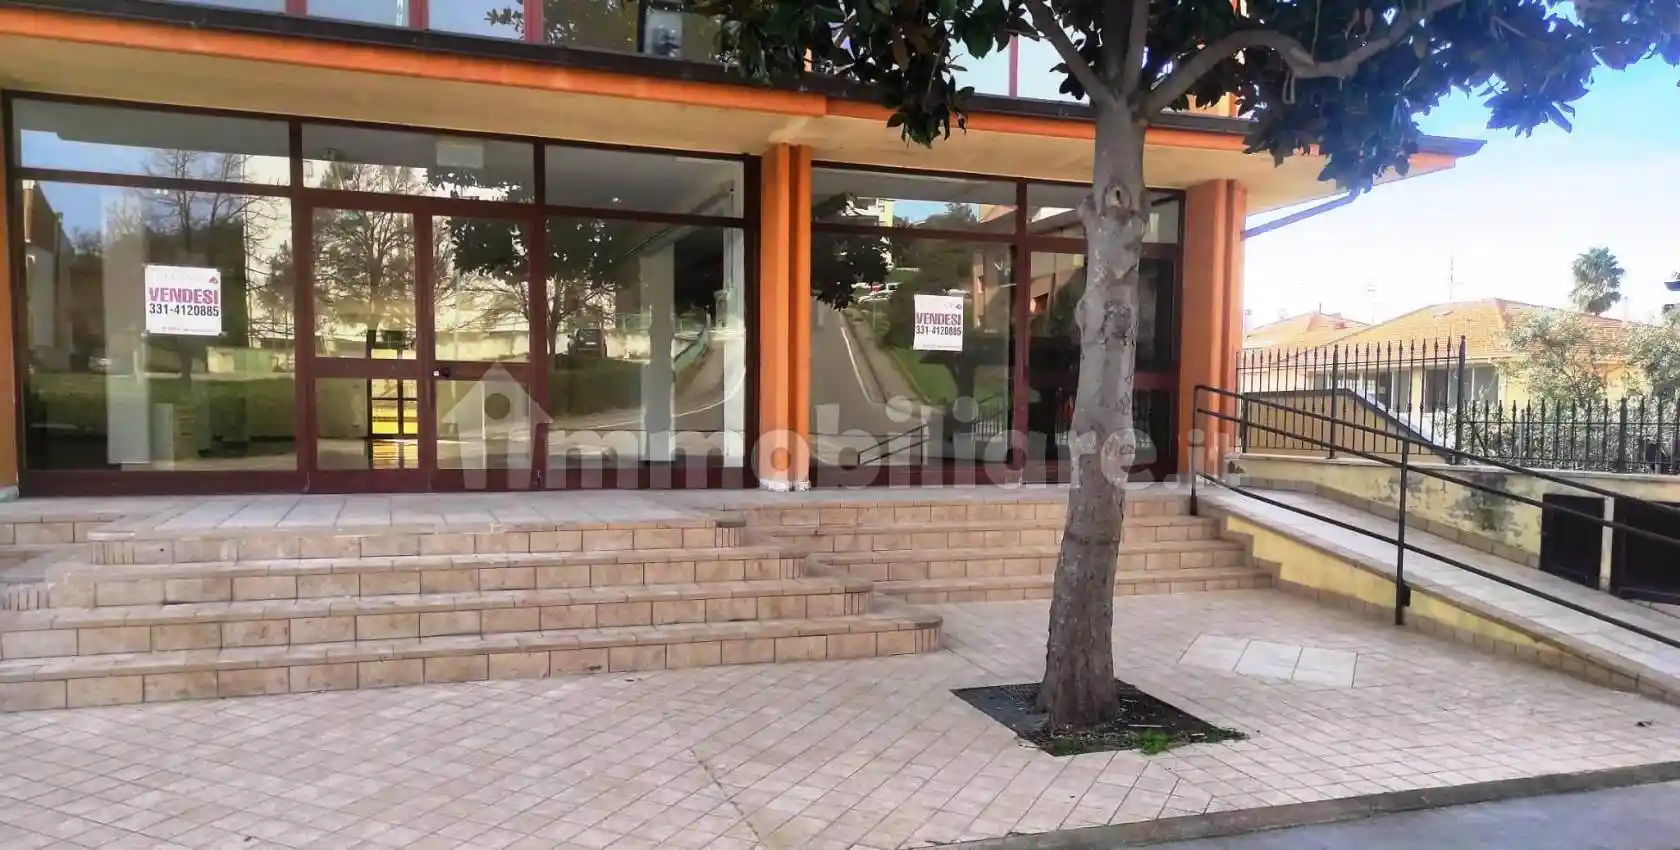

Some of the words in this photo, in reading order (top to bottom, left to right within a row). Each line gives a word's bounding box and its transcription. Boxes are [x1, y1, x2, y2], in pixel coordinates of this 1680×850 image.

[148, 287, 219, 305] VENDESI
[149, 303, 220, 317] 331-4120885
[916, 312, 962, 326] VENDESI
